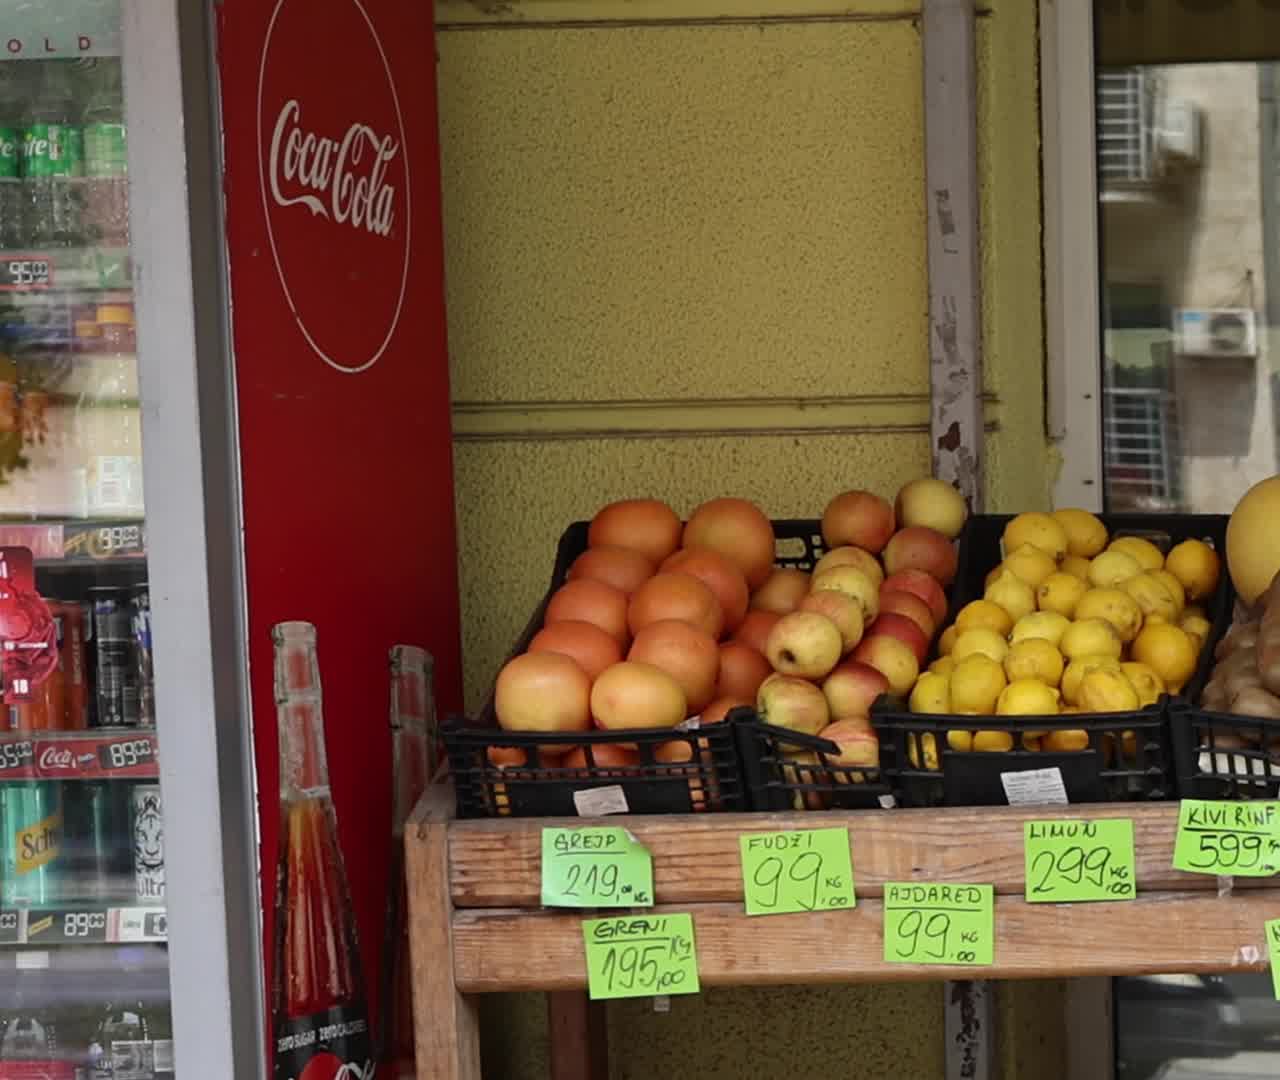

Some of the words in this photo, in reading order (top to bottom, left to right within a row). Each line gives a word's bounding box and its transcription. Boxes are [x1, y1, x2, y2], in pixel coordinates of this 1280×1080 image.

[270, 100, 400, 236] Coca-Cola
[1030, 823, 1097, 839] LIMUN
[554, 834, 617, 850] GREJP
[889, 886, 982, 904] AJDARED
